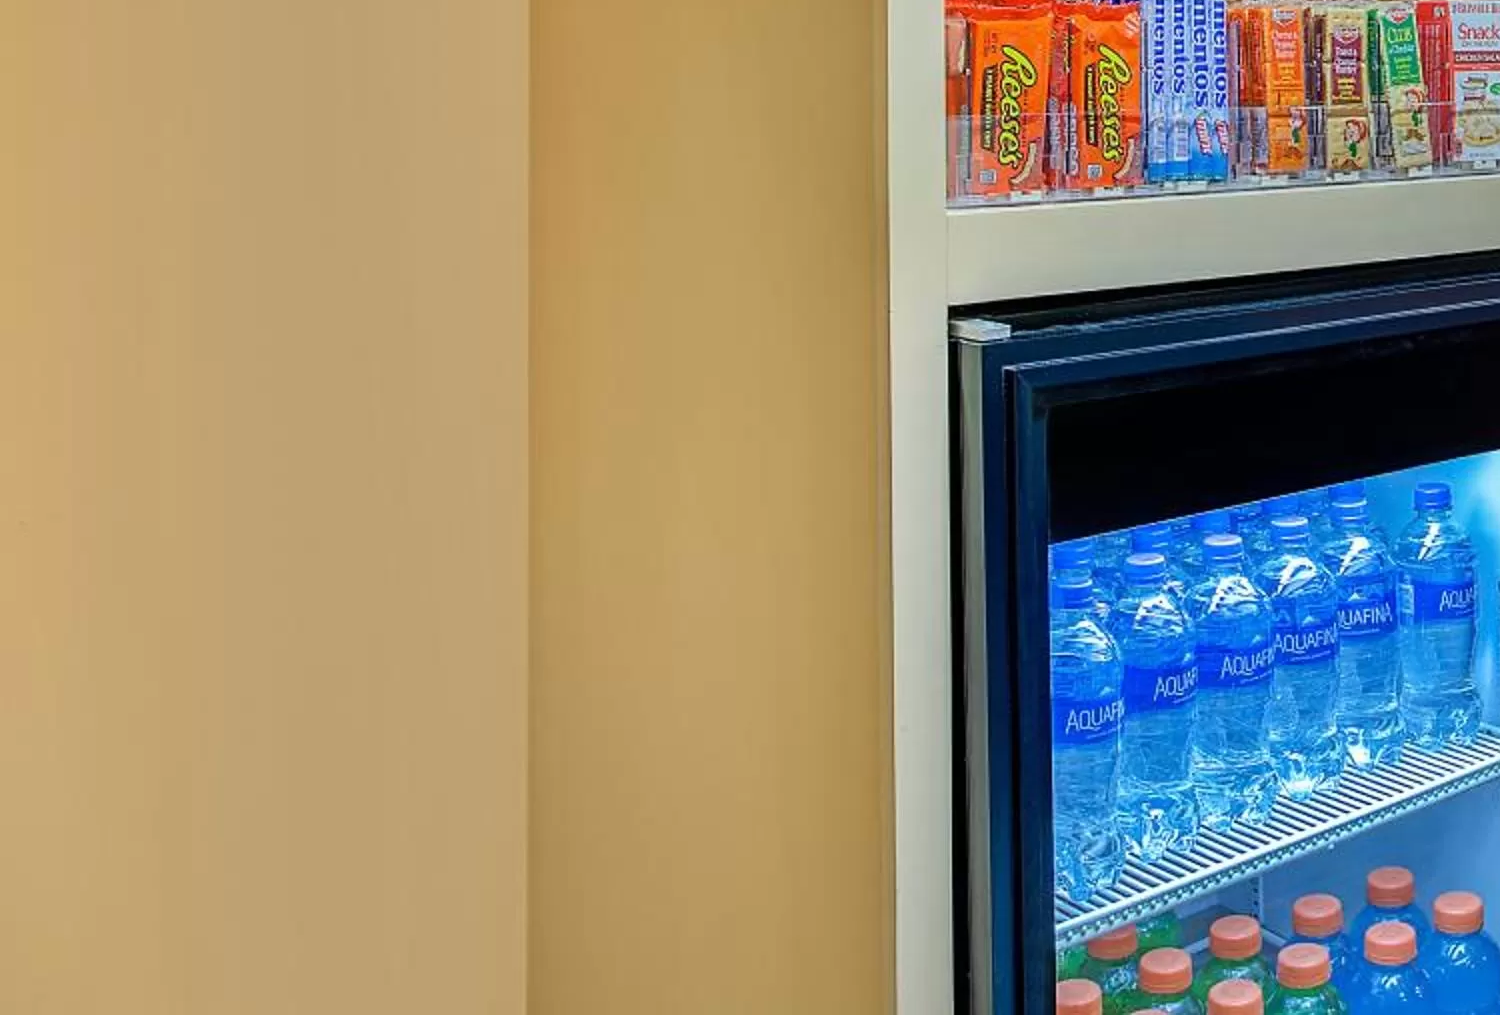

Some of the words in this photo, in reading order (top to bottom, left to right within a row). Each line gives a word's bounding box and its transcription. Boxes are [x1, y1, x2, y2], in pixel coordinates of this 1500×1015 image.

[999, 44, 1038, 169] Reese's
[1098, 43, 1133, 162] Reese's
[1213, 0, 1227, 108] mentos
[1273, 620, 1338, 654] AQUAFIN
